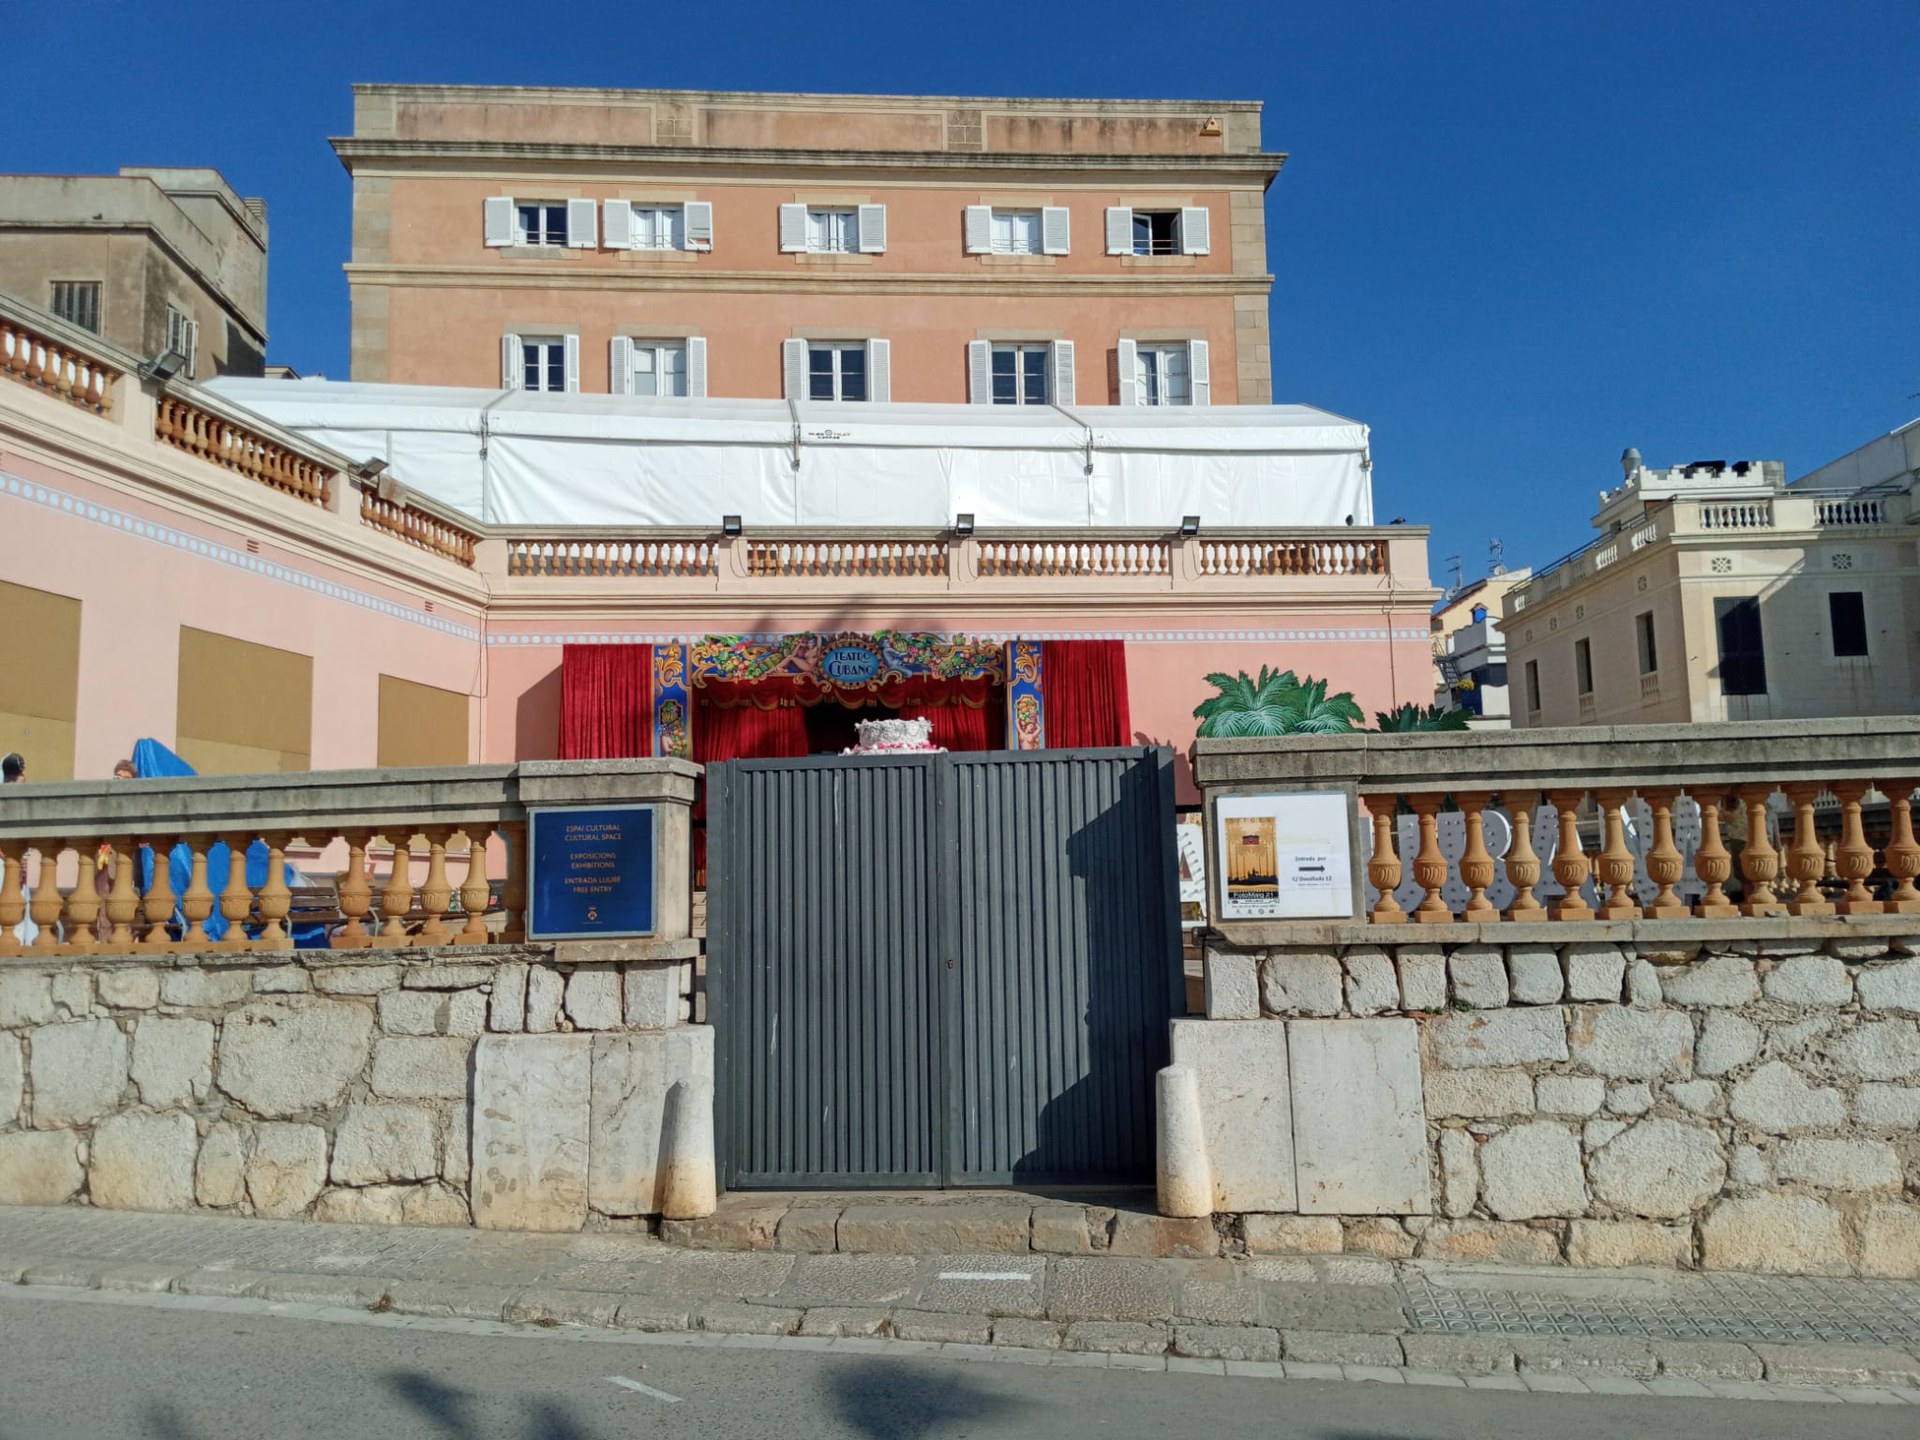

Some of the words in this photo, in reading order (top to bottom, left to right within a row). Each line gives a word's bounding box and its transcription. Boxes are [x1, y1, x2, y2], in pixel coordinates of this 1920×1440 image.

[834, 651, 870, 661] TEATRO
[585, 824, 621, 832] CULTURAL
[564, 834, 600, 842] CULTURAL
[573, 886, 588, 894] FREE
[589, 885, 613, 893] ENTRY
